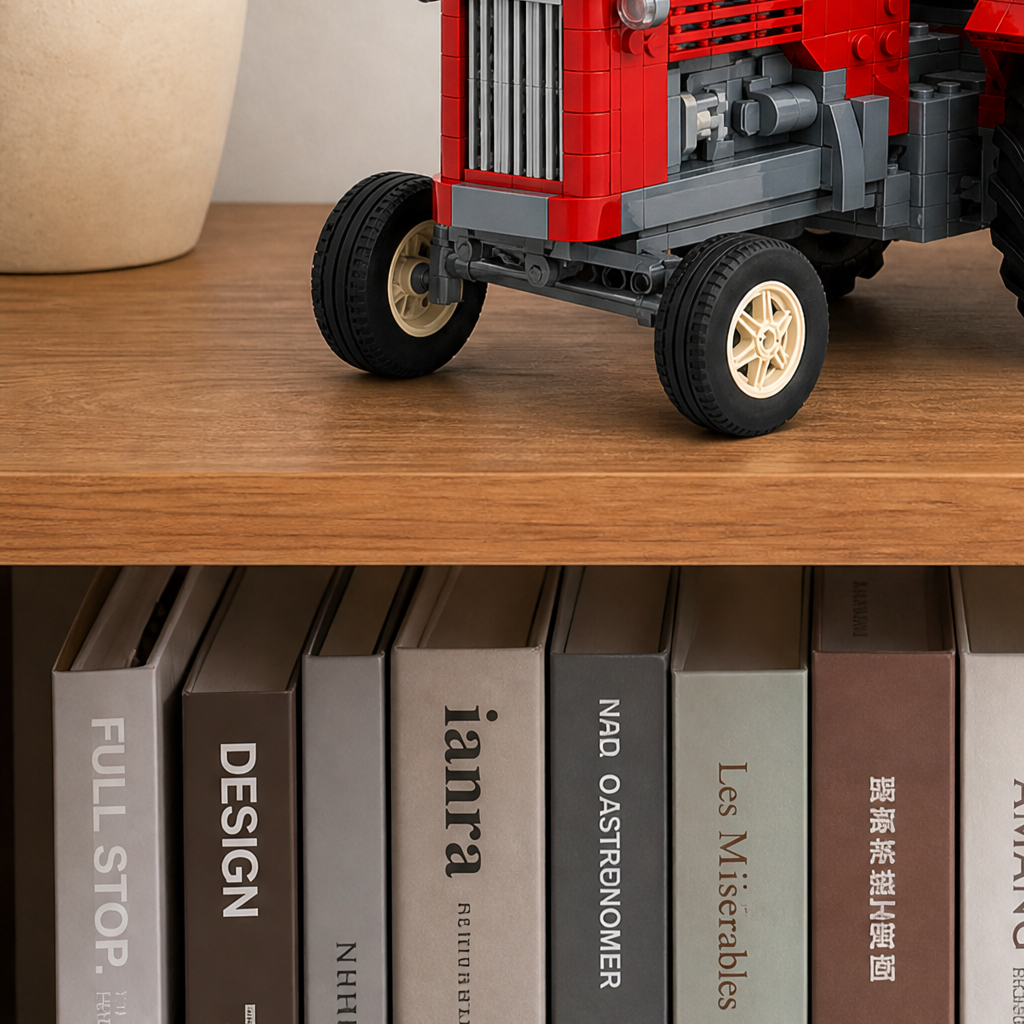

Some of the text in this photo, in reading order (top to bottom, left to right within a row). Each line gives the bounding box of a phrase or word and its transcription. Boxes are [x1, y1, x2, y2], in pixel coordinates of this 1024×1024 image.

[92, 718, 126, 831] FULL
[220, 743, 258, 918] DESIGN
[444, 705, 498, 878] ianra
[719, 762, 748, 816] Les
[94, 846, 128, 973] STOP.
